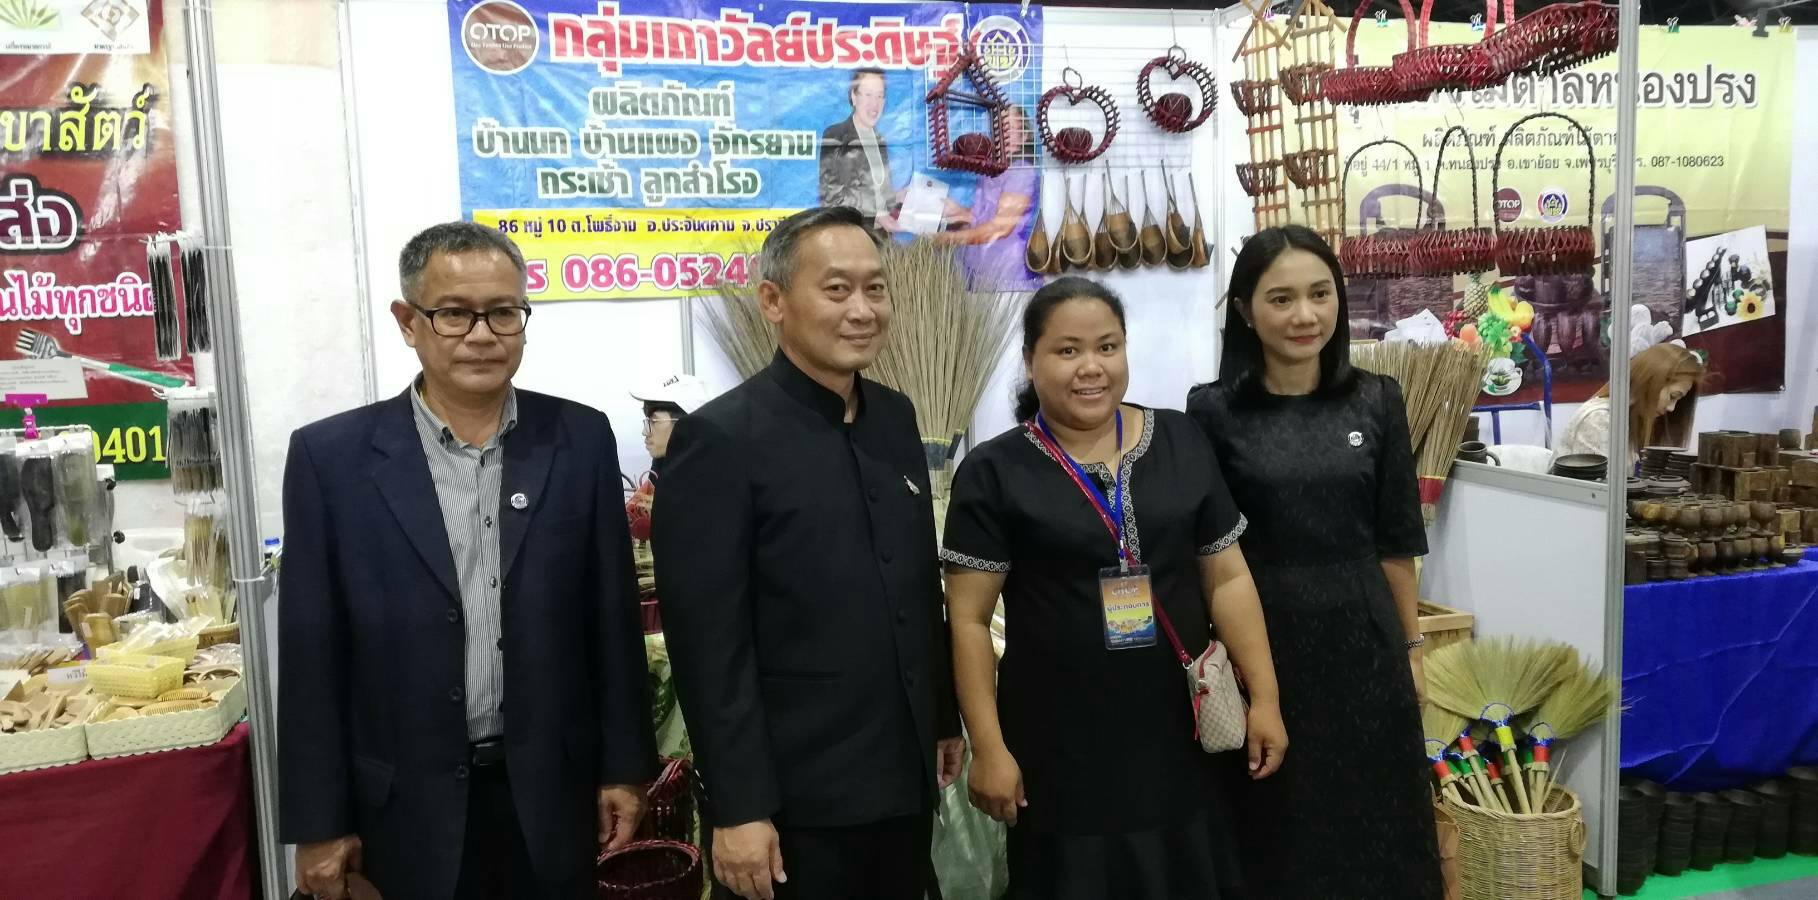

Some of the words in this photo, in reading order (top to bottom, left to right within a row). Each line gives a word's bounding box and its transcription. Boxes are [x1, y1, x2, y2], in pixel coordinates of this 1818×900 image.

[469, 22, 532, 41] OTOP
[591, 83, 732, 118] ผลิตภัณฑ์
[475, 121, 569, 155] บ้านนก
[711, 125, 814, 156] จักรยาน
[1651, 155, 1725, 168] 087-1080623
[541, 162, 629, 195] กระเช้า
[643, 160, 758, 203] ลูกสำโรง
[498, 219, 519, 233] 86
[523, 217, 542, 238] หมู่
[547, 219, 566, 233] 10
[564, 256, 758, 290] 086-0524
